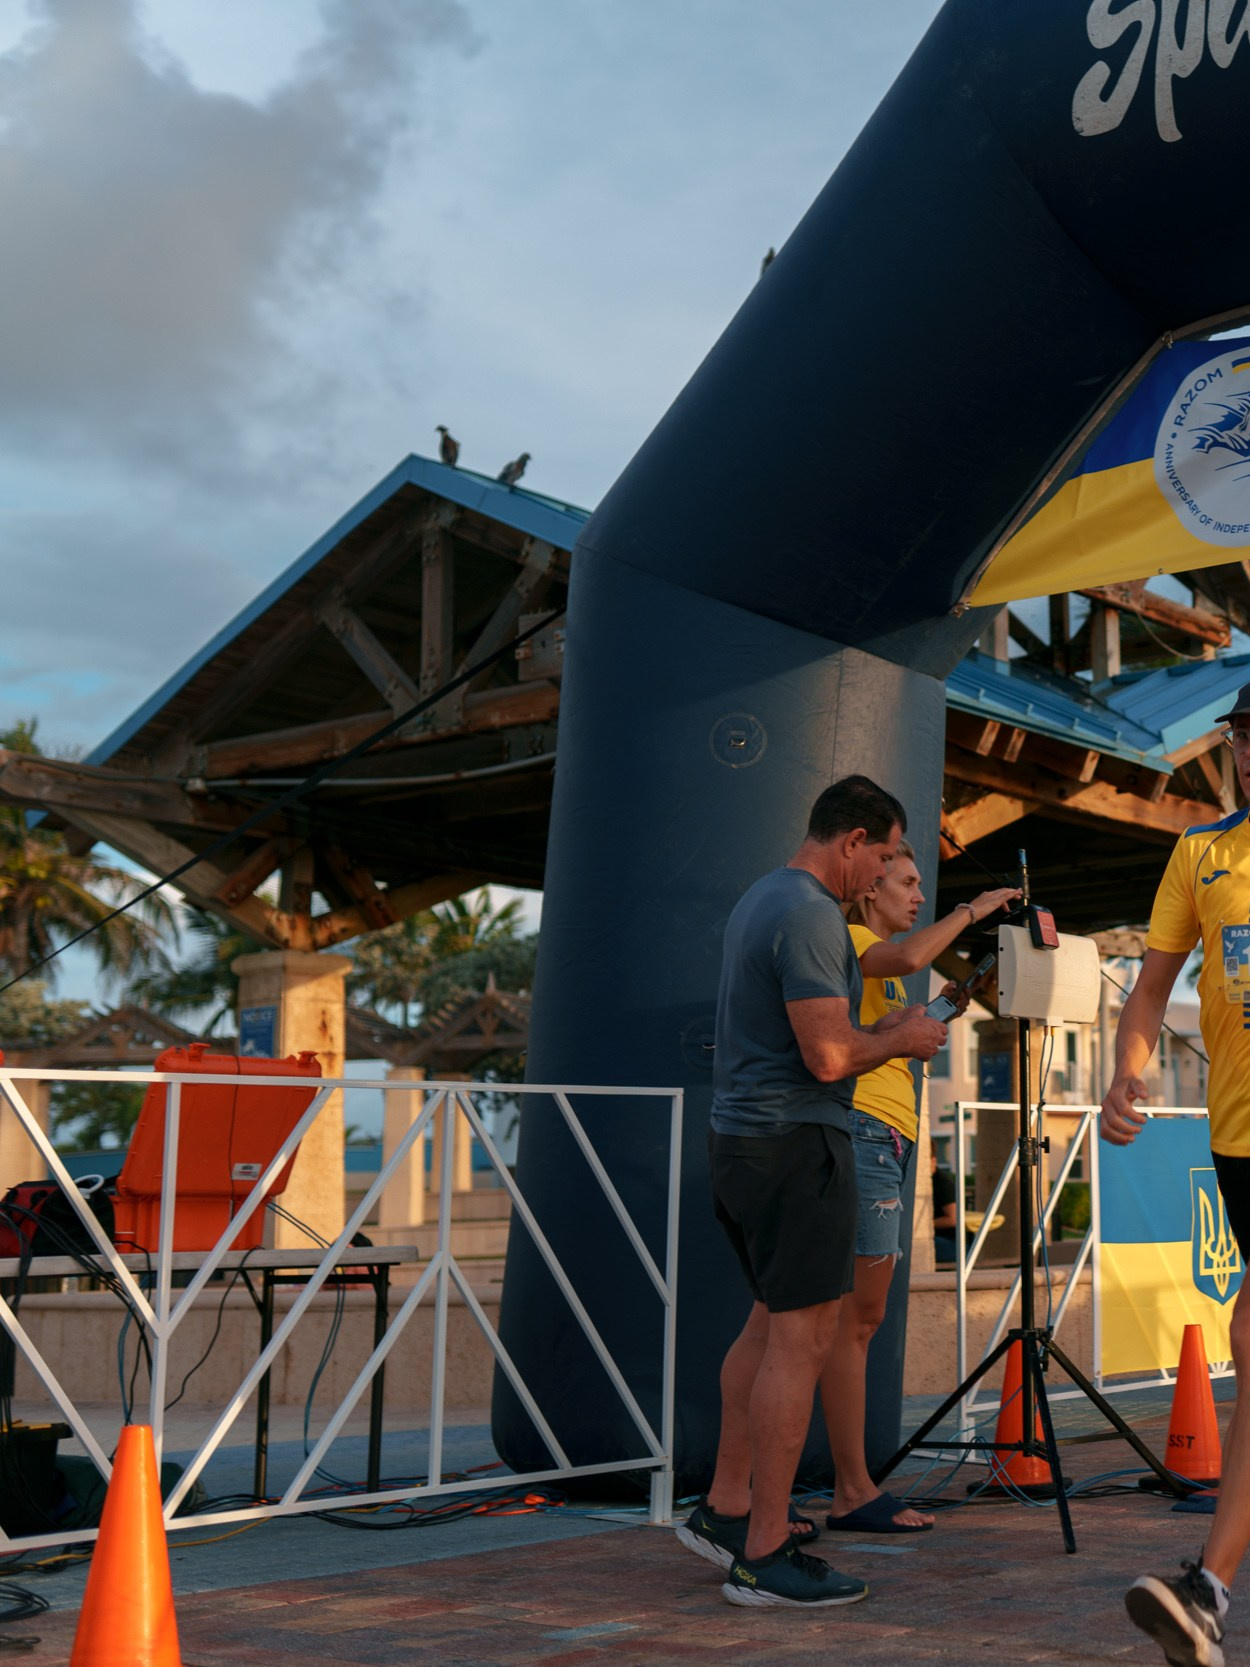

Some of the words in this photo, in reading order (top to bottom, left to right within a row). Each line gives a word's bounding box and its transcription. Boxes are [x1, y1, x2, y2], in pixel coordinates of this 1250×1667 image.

[1173, 367, 1224, 427] RAZOM
[1164, 443, 1202, 518] ANNIVERSARY
[1199, 514, 1214, 526] OF
[1168, 1434, 1195, 1449] SST
